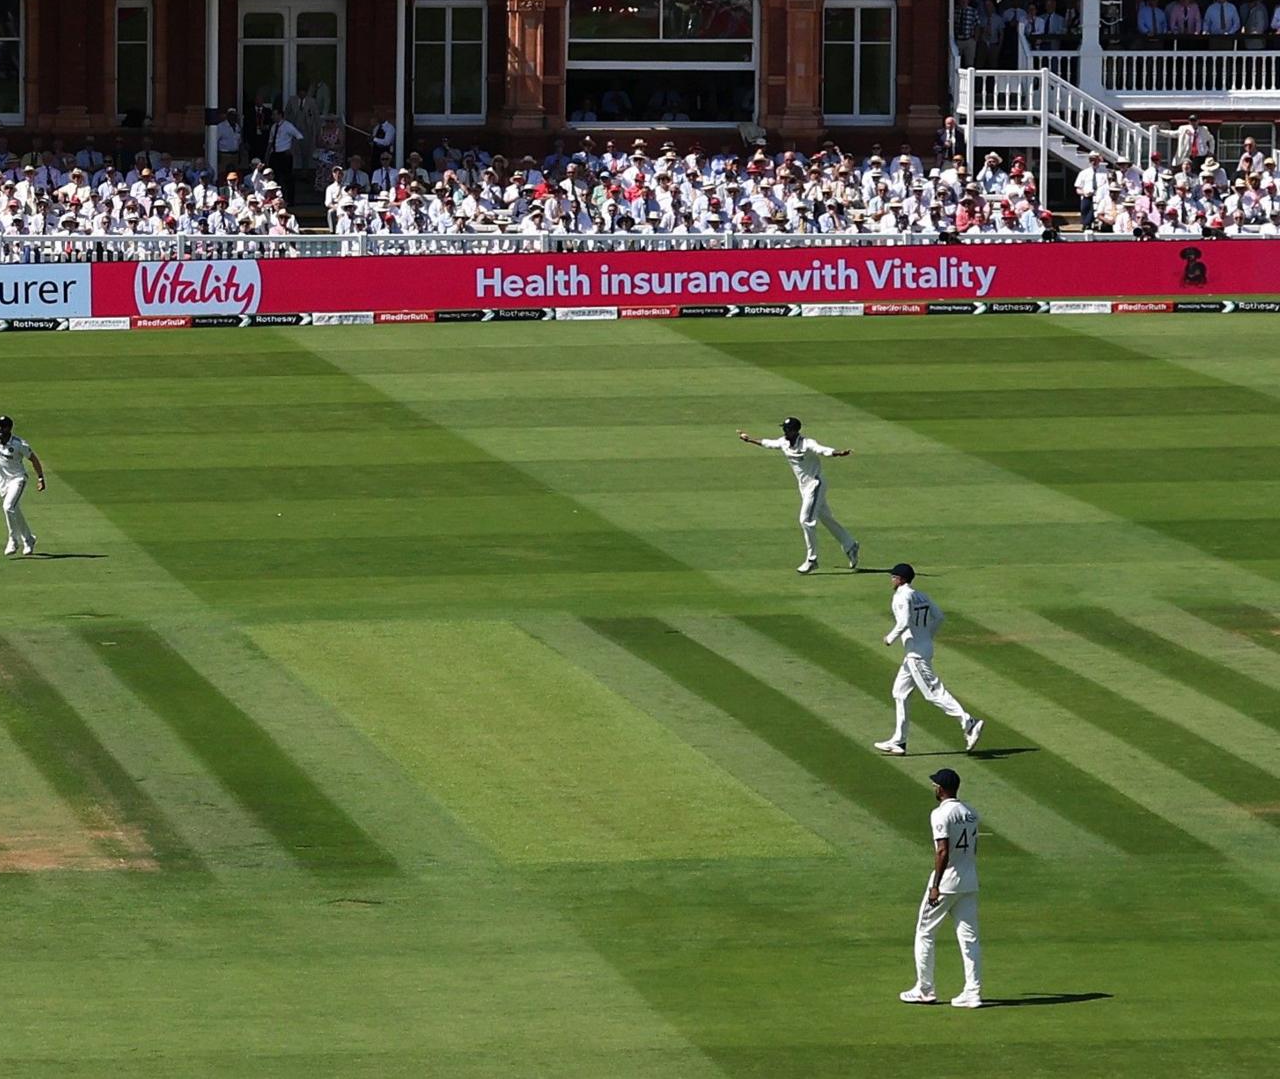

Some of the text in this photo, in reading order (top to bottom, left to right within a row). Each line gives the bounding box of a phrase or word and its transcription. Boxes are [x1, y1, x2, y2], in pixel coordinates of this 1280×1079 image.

[477, 257, 996, 296] Health insurance with Vitality
[141, 261, 254, 314] Vitality
[256, 316, 297, 324] Rothesay
[381, 313, 428, 321] #RedforRuth
[13, 321, 53, 329] Rothesay
[914, 605, 930, 627] 77
